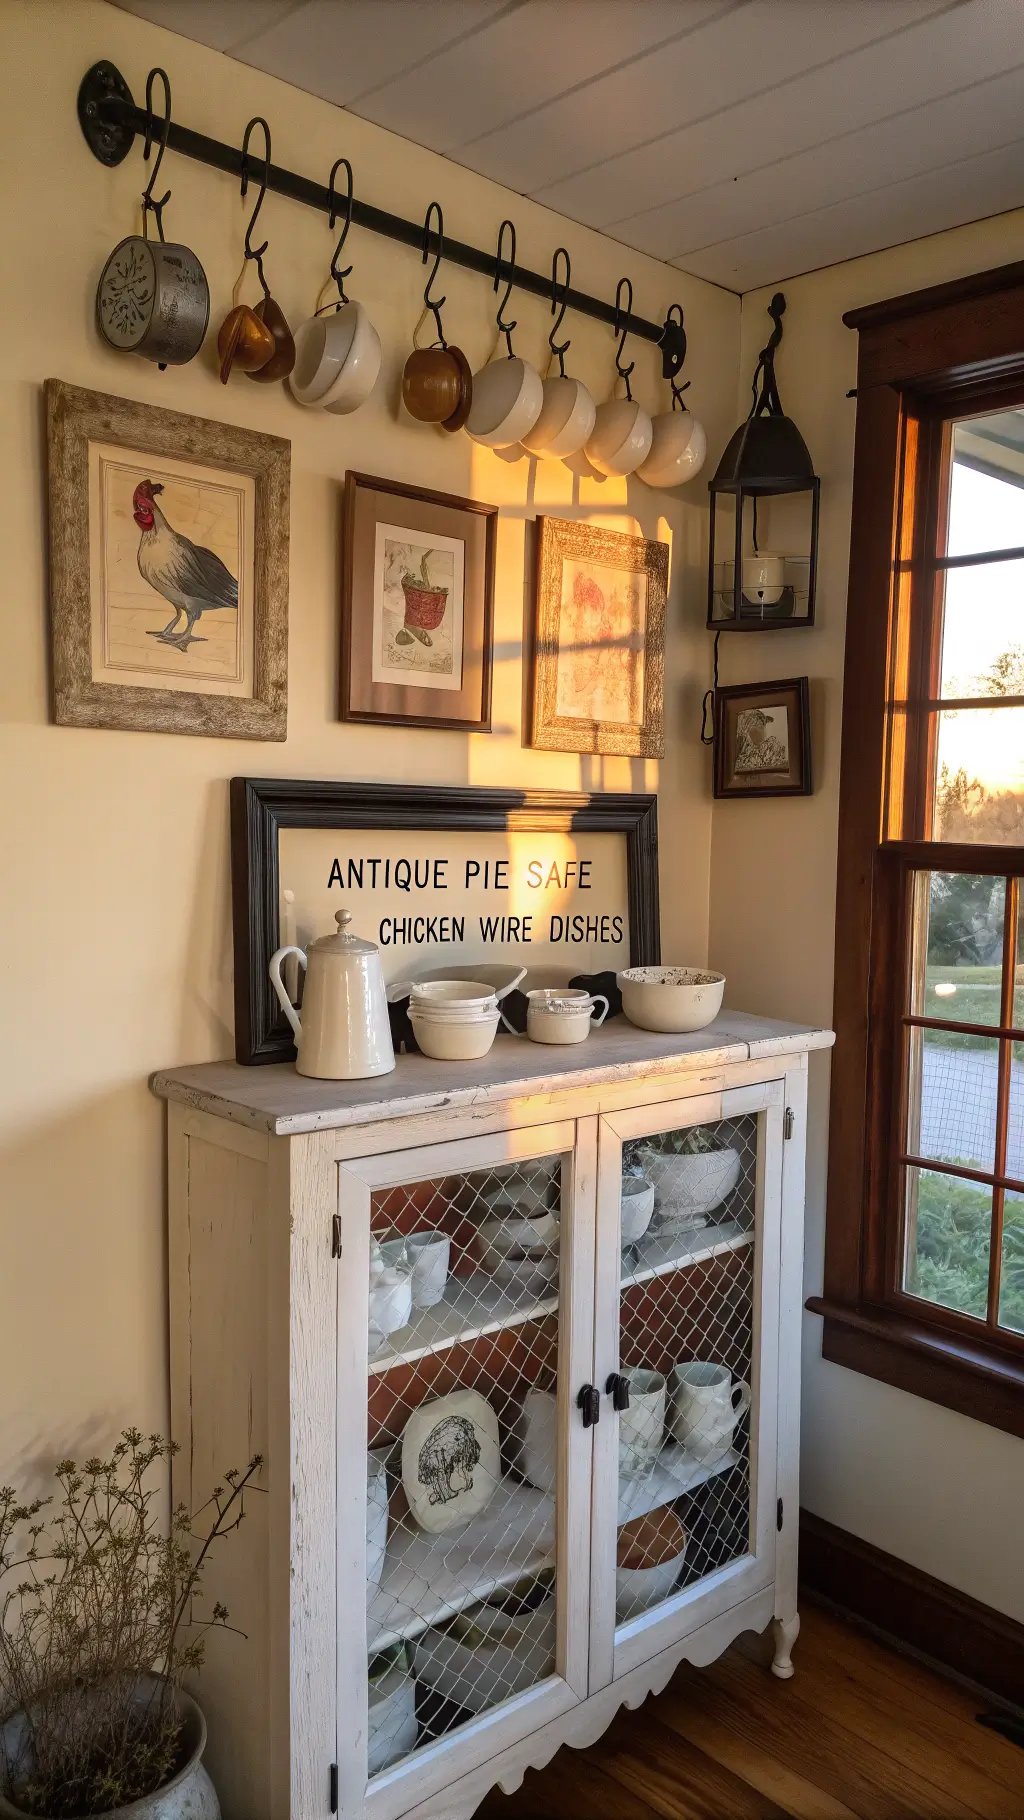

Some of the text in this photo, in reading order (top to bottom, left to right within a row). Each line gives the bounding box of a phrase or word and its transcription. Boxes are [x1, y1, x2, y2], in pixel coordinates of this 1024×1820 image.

[327, 858, 593, 892] ANTIQUE PIE SAFE
[379, 915, 624, 945] CHICKEN WIRE DISHES
